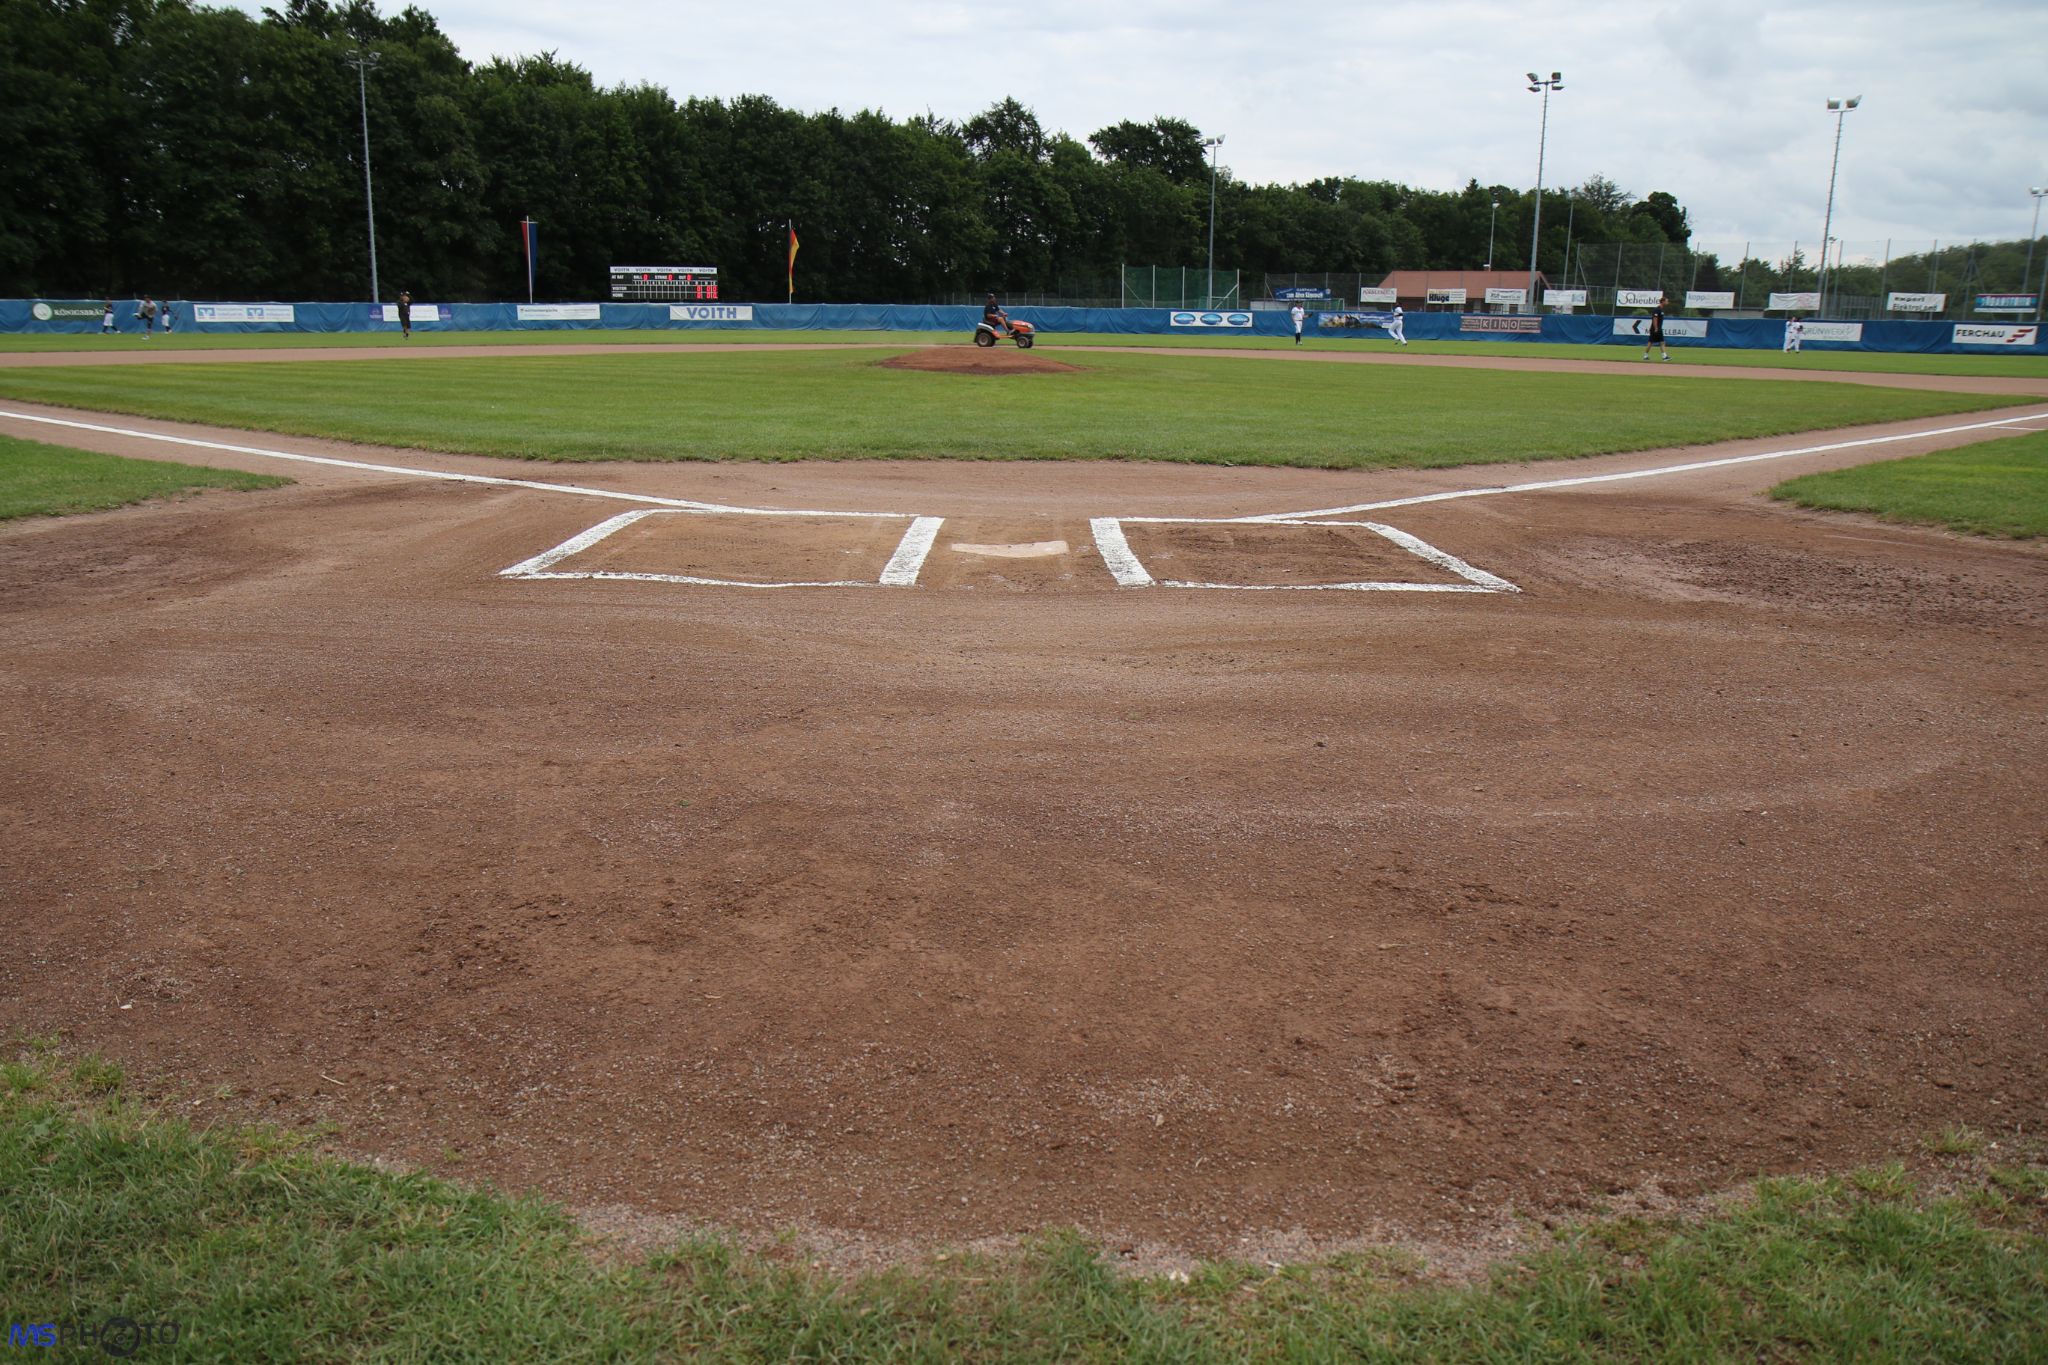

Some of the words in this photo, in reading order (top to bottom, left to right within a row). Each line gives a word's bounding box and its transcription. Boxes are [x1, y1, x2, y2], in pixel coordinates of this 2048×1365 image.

[686, 307, 737, 319] VOITH
[1482, 319, 1518, 328] KINO
[1956, 329, 2006, 338] FERCHAU
